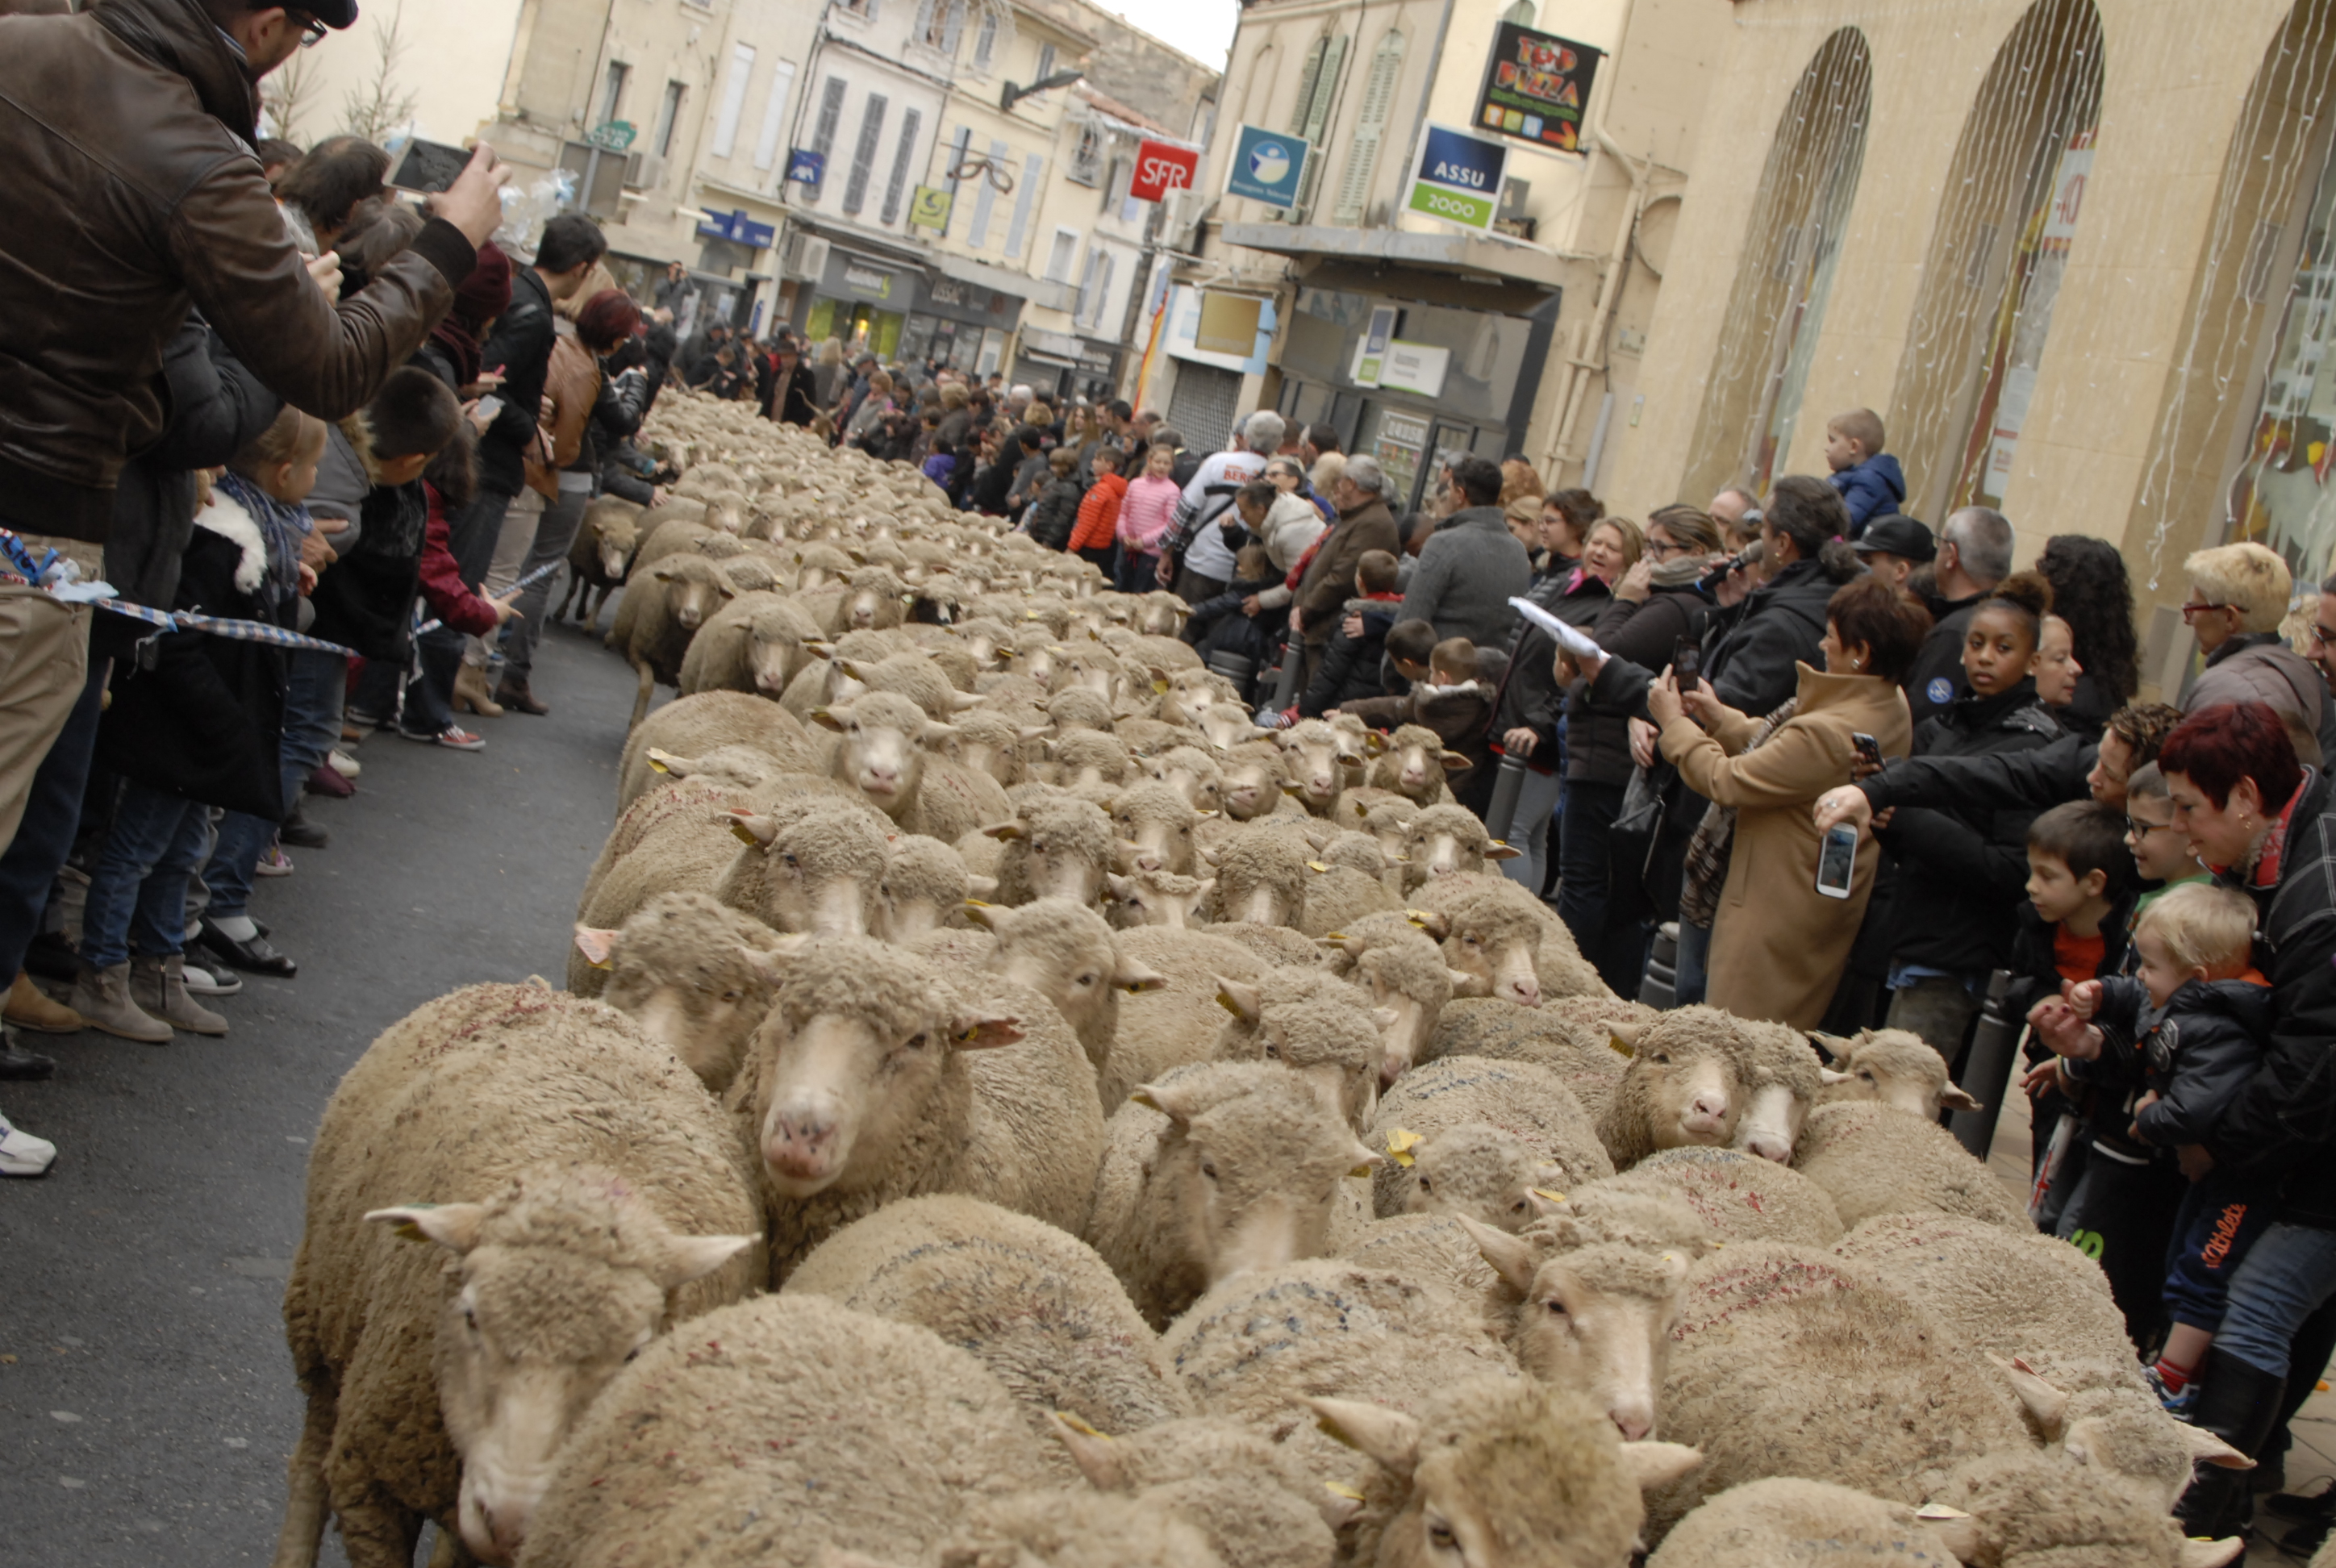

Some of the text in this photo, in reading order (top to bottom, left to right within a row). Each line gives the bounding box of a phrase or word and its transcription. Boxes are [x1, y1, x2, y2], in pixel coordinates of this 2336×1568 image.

[1495, 60, 1579, 108] PIZZA
[1141, 156, 1187, 187] SFR
[1434, 161, 1485, 188] ASSU
[1428, 194, 1475, 219] 2000
